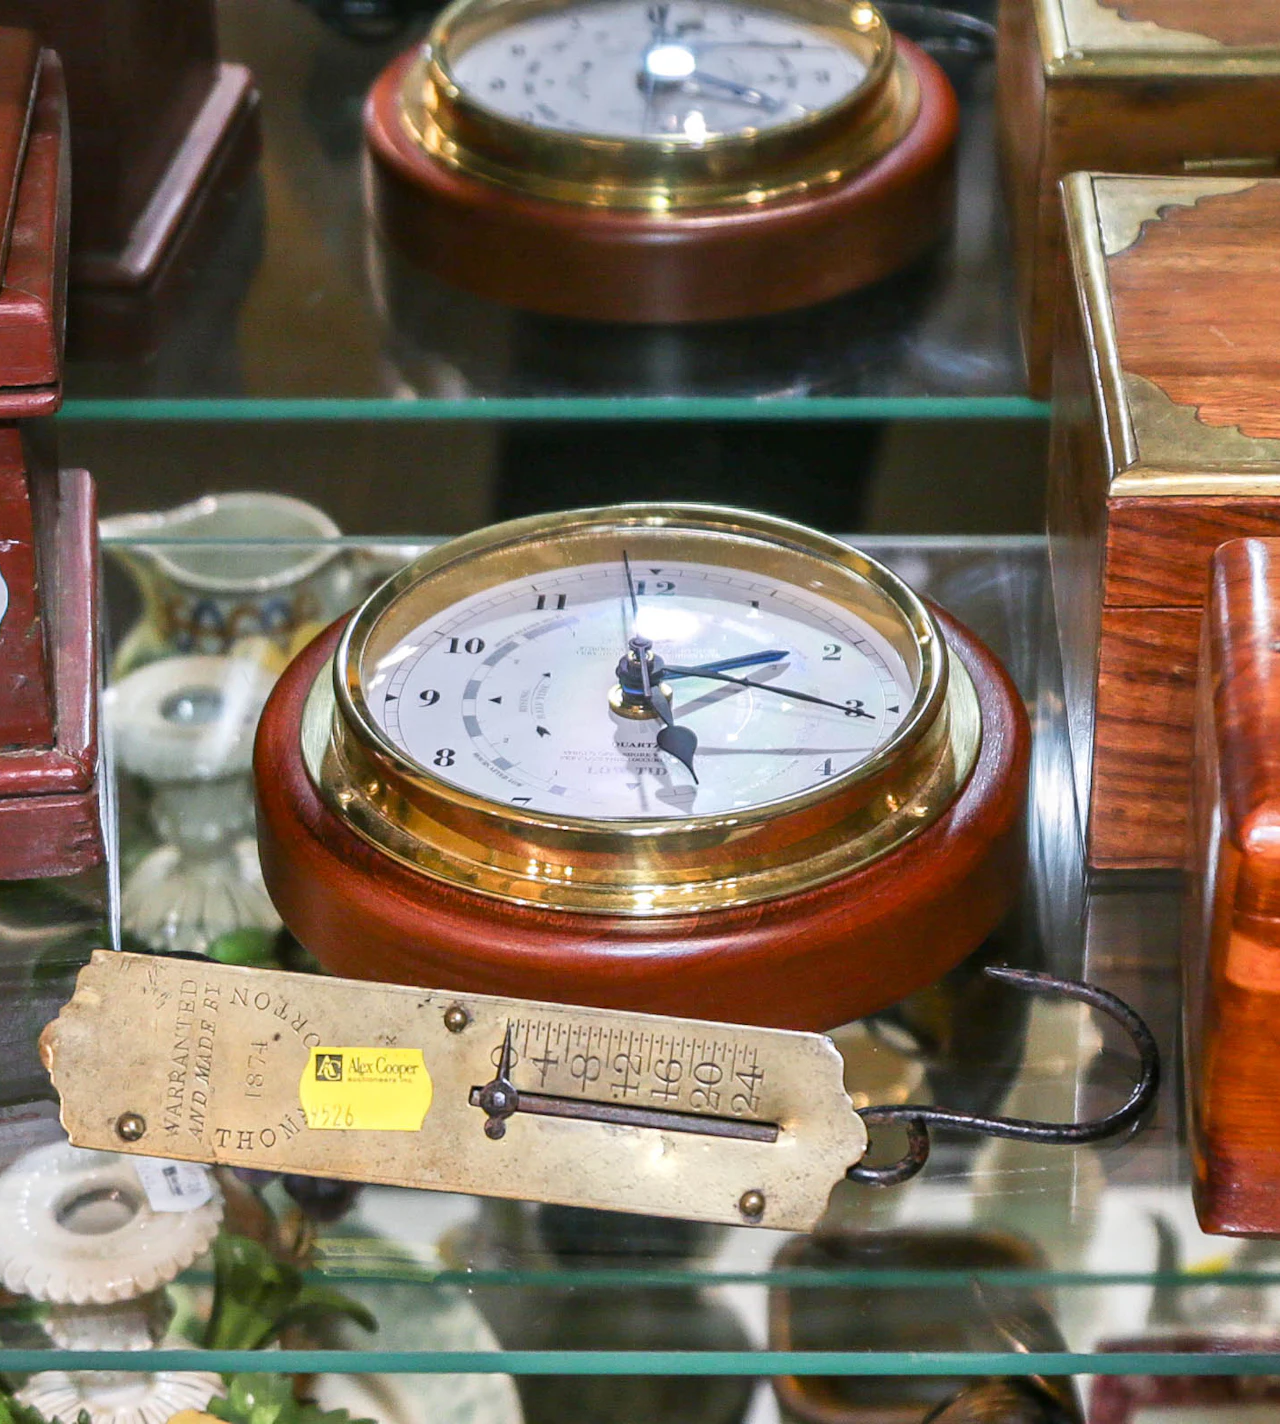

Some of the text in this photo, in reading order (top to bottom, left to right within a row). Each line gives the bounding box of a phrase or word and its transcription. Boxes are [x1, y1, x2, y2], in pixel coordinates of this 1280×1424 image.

[636, 580, 676, 596] 12
[535, 593, 568, 611] 11
[444, 637, 485, 654] 10
[822, 643, 842, 661] 2
[419, 689, 440, 707] 9
[844, 699, 865, 718] 3
[433, 748, 456, 768] 8
[813, 757, 837, 776] 4
[635, 766, 669, 776] TID
[163, 979, 198, 1139] WARRANTED
[188, 982, 221, 1142] AND MADE BY
[348, 1056, 419, 1079] Alex Cooper
[244, 1040, 268, 1100] 1874
[531, 1051, 560, 1083] 4
[571, 1053, 601, 1084] 8
[610, 1052, 643, 1099] 12
[651, 1058, 684, 1104] 16
[690, 1060, 724, 1112] 20
[731, 1066, 765, 1116] 24
